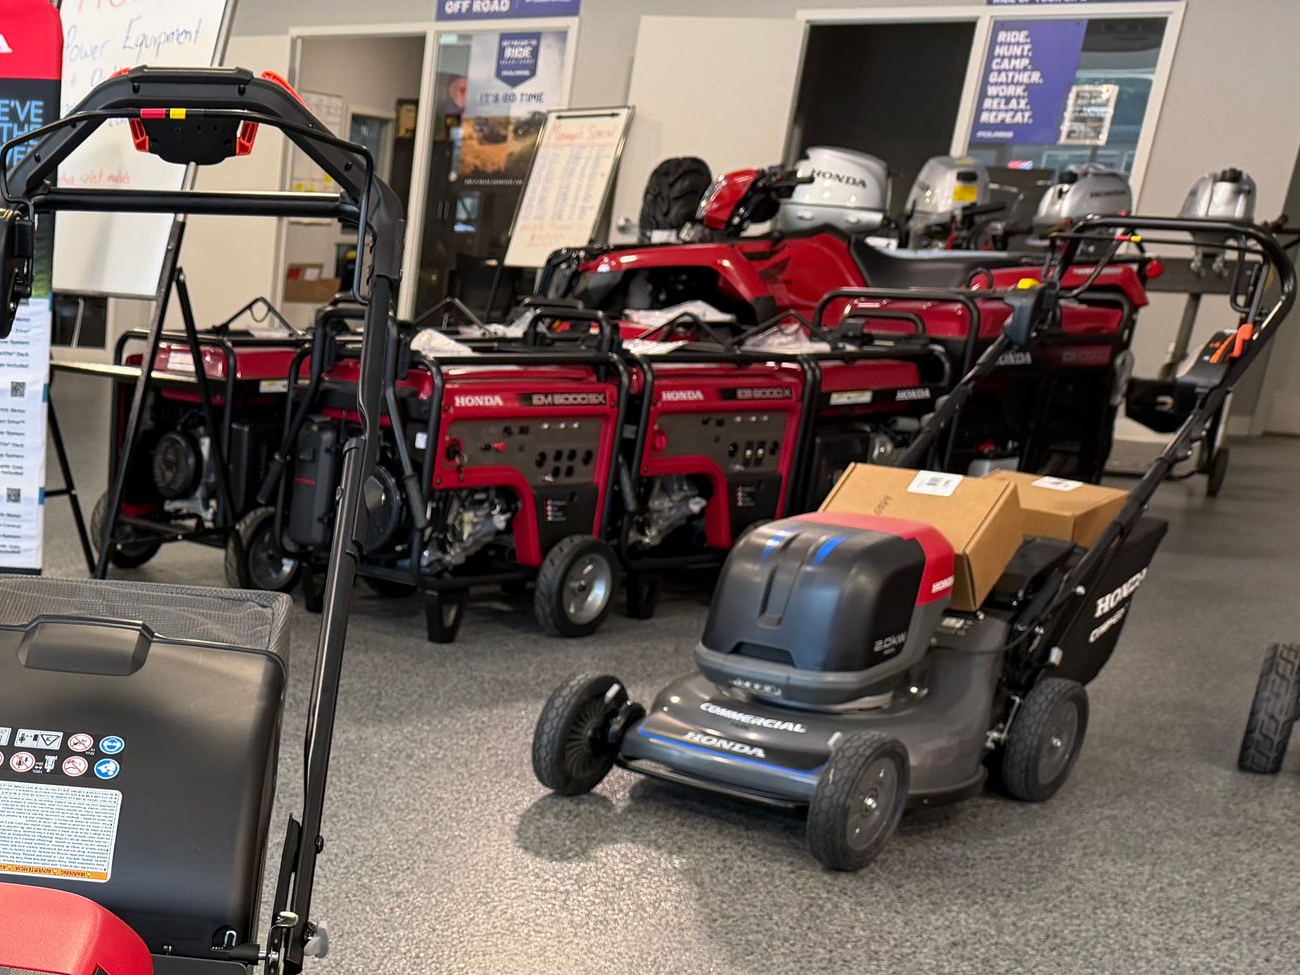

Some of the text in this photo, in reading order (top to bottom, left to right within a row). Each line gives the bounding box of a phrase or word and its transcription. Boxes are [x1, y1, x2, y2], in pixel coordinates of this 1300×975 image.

[445, 0, 511, 14] OFF ROAD
[996, 30, 1031, 43] RIDE.
[994, 44, 1033, 57] HUNT.
[991, 57, 1032, 70] CAMP.
[988, 70, 1044, 84] GATHER.
[986, 84, 1029, 97] WORK.
[982, 97, 1031, 110] RELAX.
[980, 110, 1034, 124] REPEAT.
[810, 168, 868, 189] HONDA
[454, 394, 504, 408] HONDA
[661, 389, 704, 401] HONDA
[700, 702, 807, 733] COMMERCIAL
[683, 731, 766, 758] HONDA
[59, 868, 87, 878] WARNING
